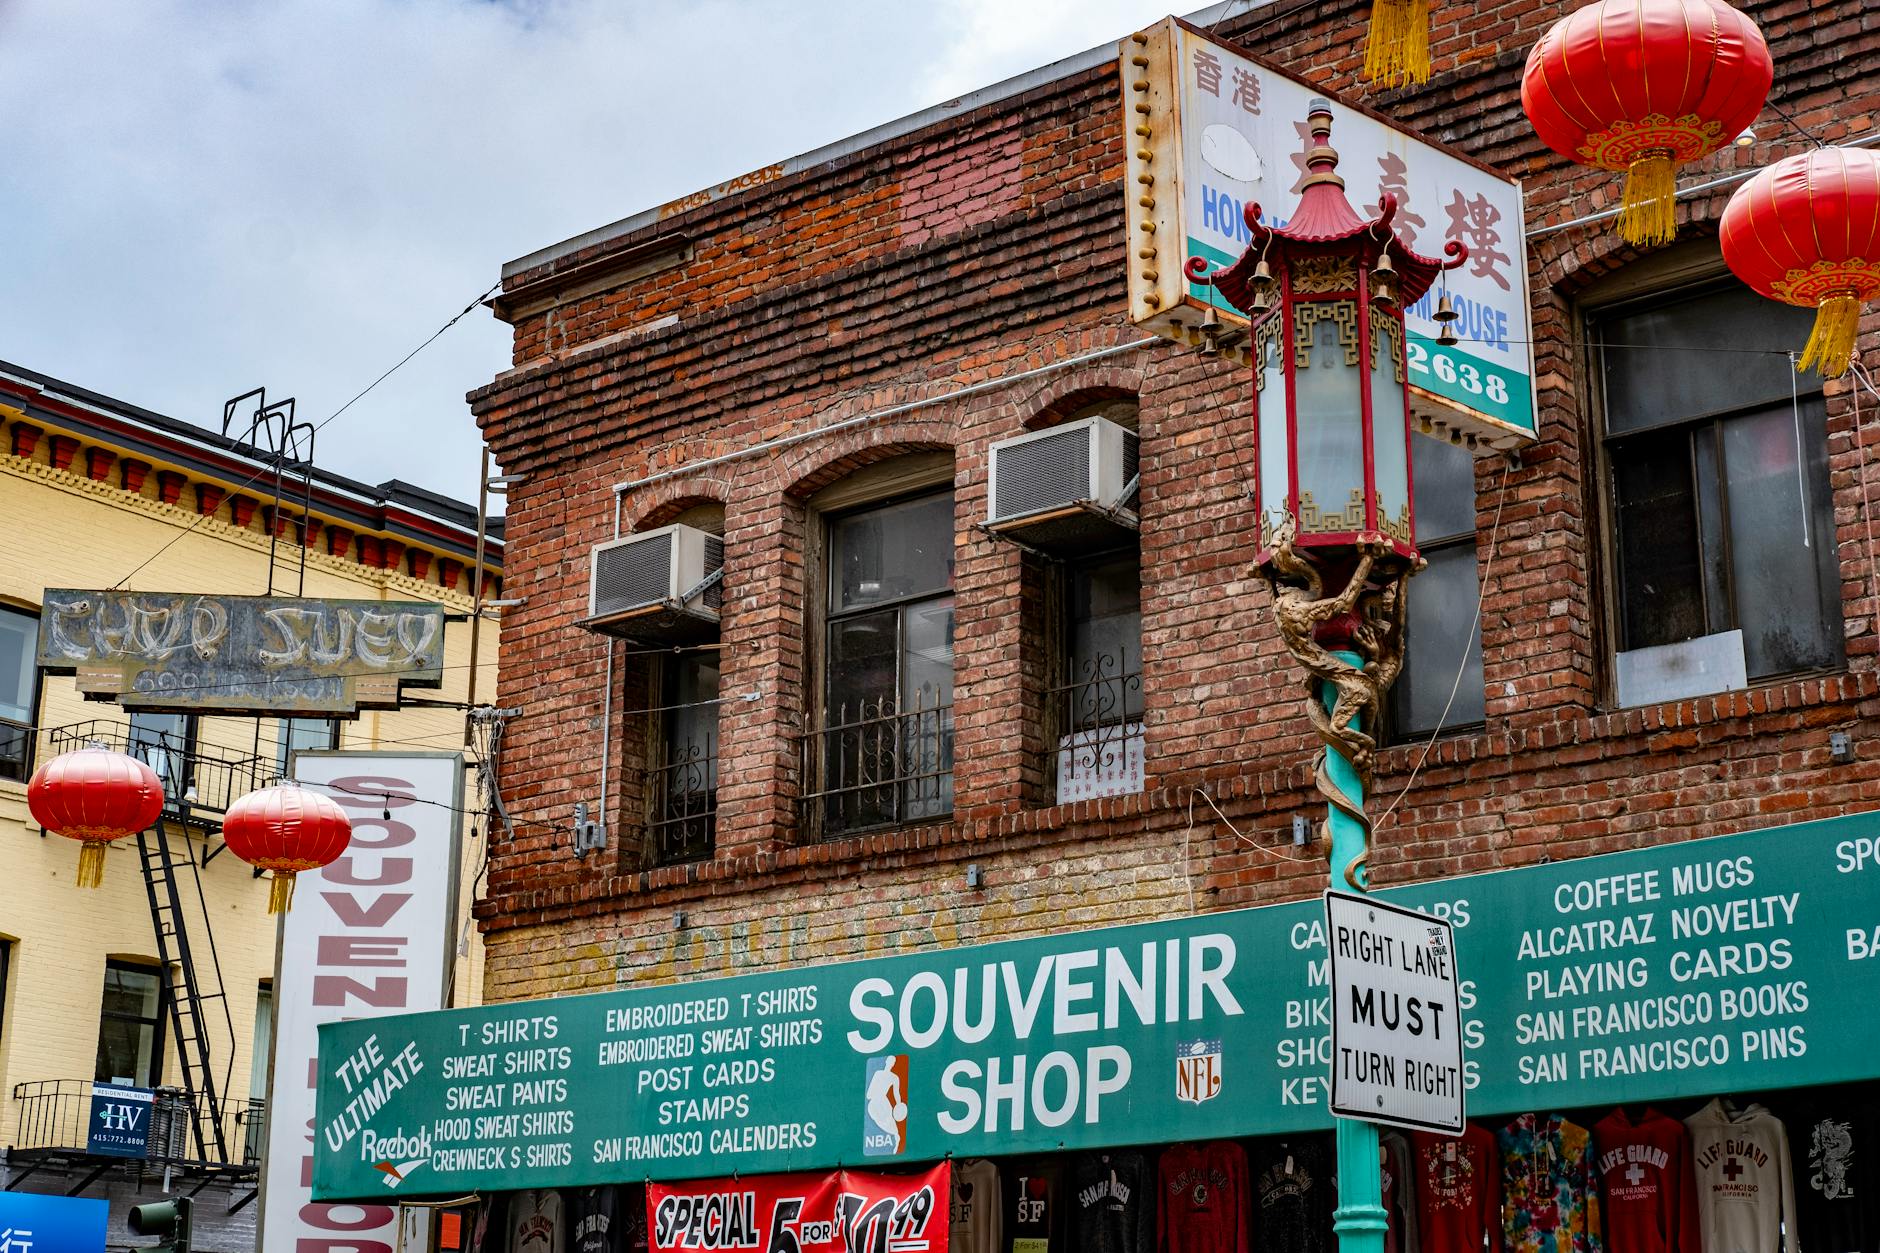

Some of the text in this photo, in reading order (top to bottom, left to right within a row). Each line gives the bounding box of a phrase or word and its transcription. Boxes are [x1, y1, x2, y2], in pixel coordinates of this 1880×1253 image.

[1194, 49, 1261, 116] 香港
[1202, 184, 1265, 245] HON
[1406, 342, 1509, 404] 2638
[312, 776, 417, 1021] SOUVEN
[1554, 856, 1754, 913] COFFEE MUGS
[1517, 913, 1656, 961] ALCATRAZ
[1671, 892, 1800, 939] NOVELTY
[1337, 926, 1450, 981] RIGHT LANE
[1526, 957, 1648, 1000] PLAYING
[1669, 938, 1793, 982] CARDS
[606, 998, 728, 1032] EMBROIDERED
[846, 933, 1245, 1054] SOUVENIR
[1351, 984, 1444, 1040] MUST
[1516, 1010, 1564, 1044] SAN
[1573, 991, 1712, 1038] FRANCISCO
[1720, 981, 1809, 1021] BOOKS
[335, 1034, 384, 1093] THE
[599, 1034, 694, 1065] EMBROIDERED
[1341, 1048, 1395, 1088] TURN
[1405, 1059, 1457, 1099] RIGHT
[1518, 1052, 1567, 1084] SAN
[1580, 1034, 1729, 1079] FRANCISCO
[1743, 1025, 1807, 1062] PINS
[98, 1090, 132, 1099] RESIDENTIAL
[325, 1041, 423, 1152] ULTIMATE
[446, 1079, 567, 1110] SWEAT PANTS
[638, 1058, 775, 1094] POST CARDS
[937, 1045, 1132, 1135] SHOP
[1178, 1056, 1221, 1101] NFL
[103, 1103, 144, 1131] HV
[435, 1111, 574, 1142] HOOD SWEAT SHIRTS
[659, 1094, 749, 1125] STAMPS
[361, 1126, 431, 1161] Reebok
[433, 1147, 505, 1171] CREWNECK
[593, 1122, 816, 1163] SAN FRANCISCO CALENDERS
[865, 1135, 893, 1148] NBA
[1599, 1144, 1669, 1175] LIFE GUARD
[1697, 1139, 1769, 1170] LIFE GUARD
[655, 1191, 760, 1250] SPECIAL
[802, 1223, 831, 1244] FOR
[1018, 1201, 1045, 1223] SF
